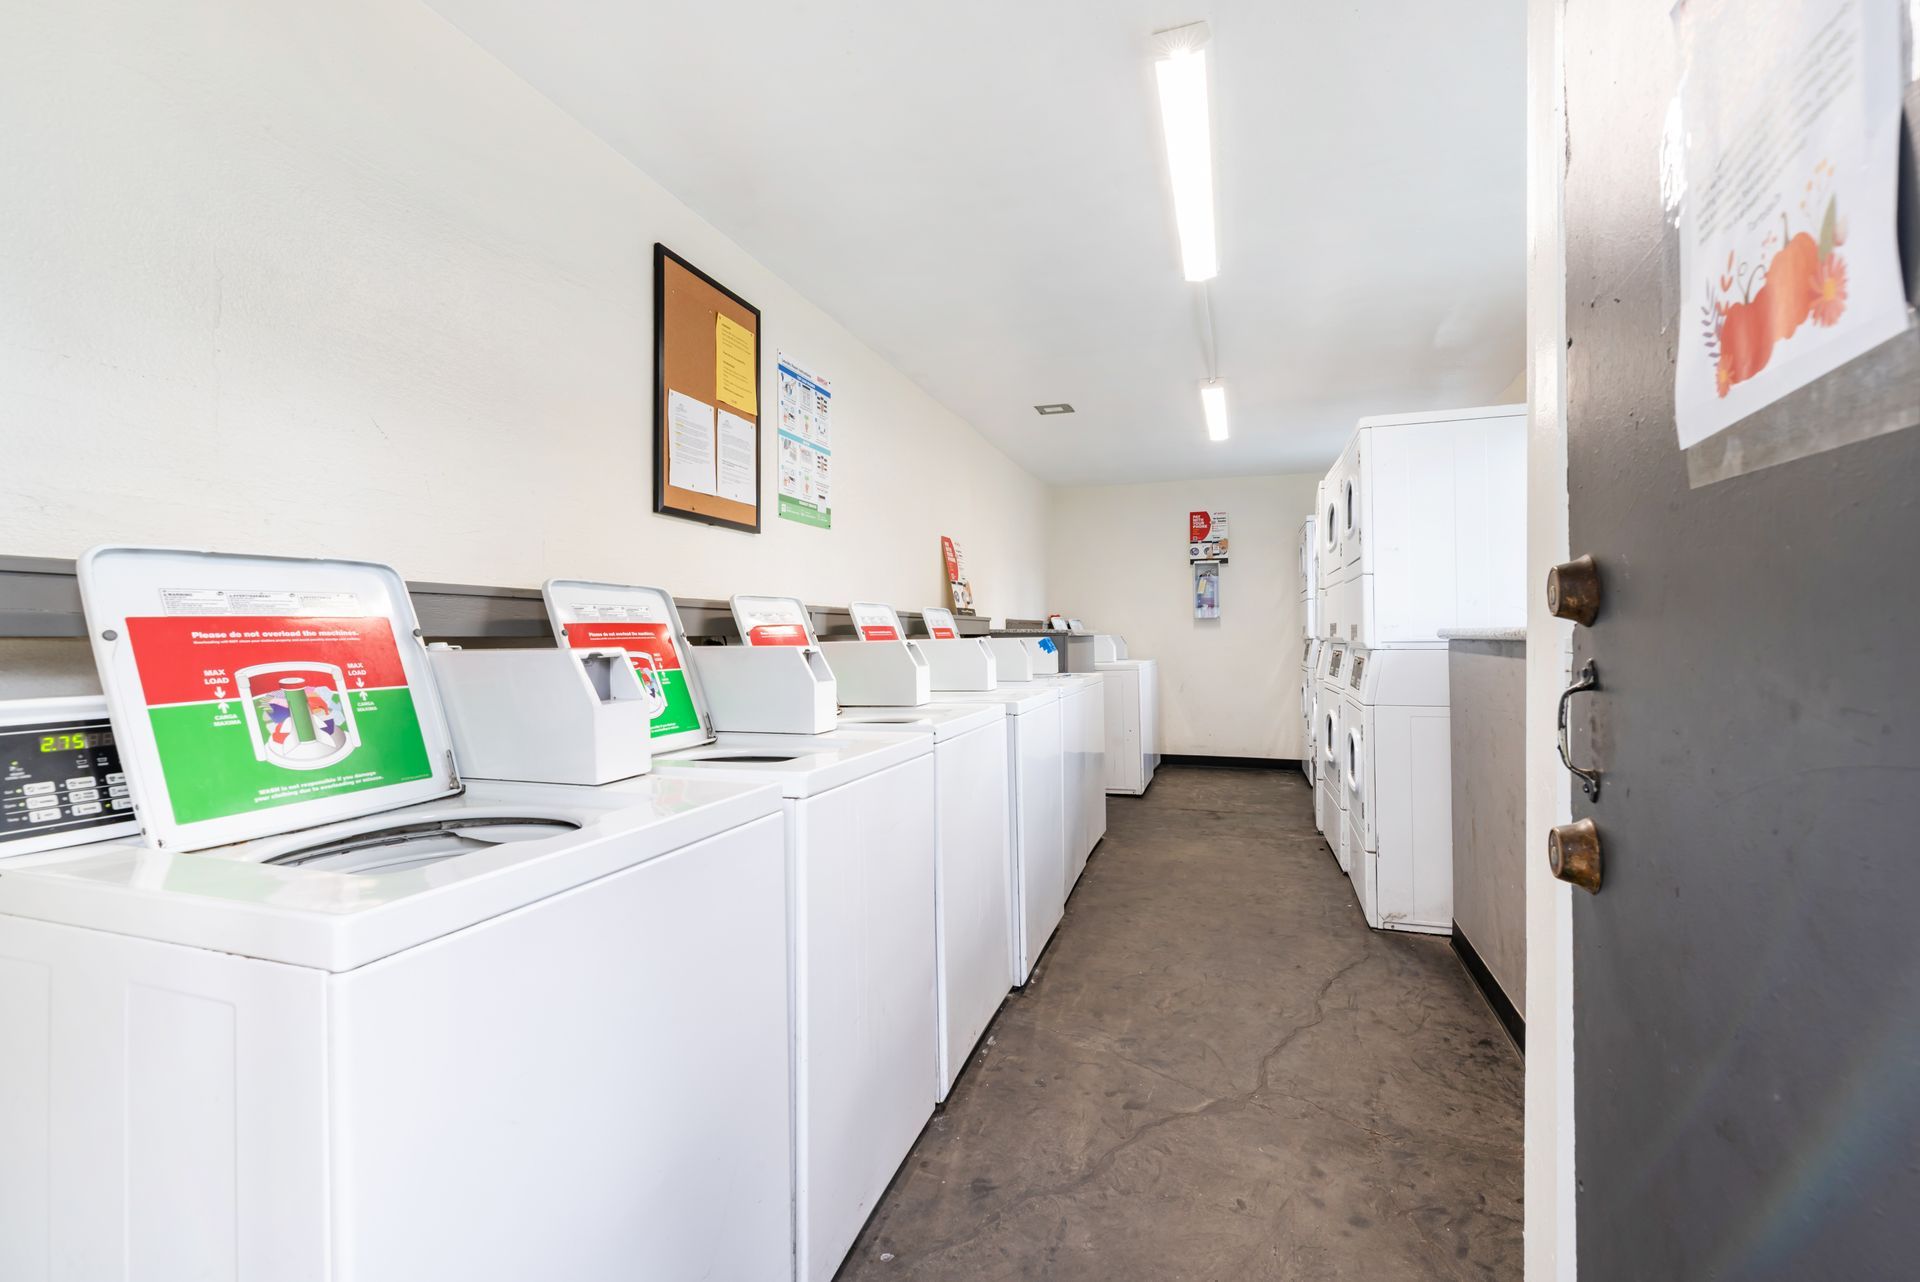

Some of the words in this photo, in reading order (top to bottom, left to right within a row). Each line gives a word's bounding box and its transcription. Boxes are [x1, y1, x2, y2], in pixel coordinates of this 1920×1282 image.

[191, 631, 226, 639] Please
[203, 669, 226, 677] MAX
[204, 677, 230, 685] LOAD
[40, 733, 85, 753] 2.75
